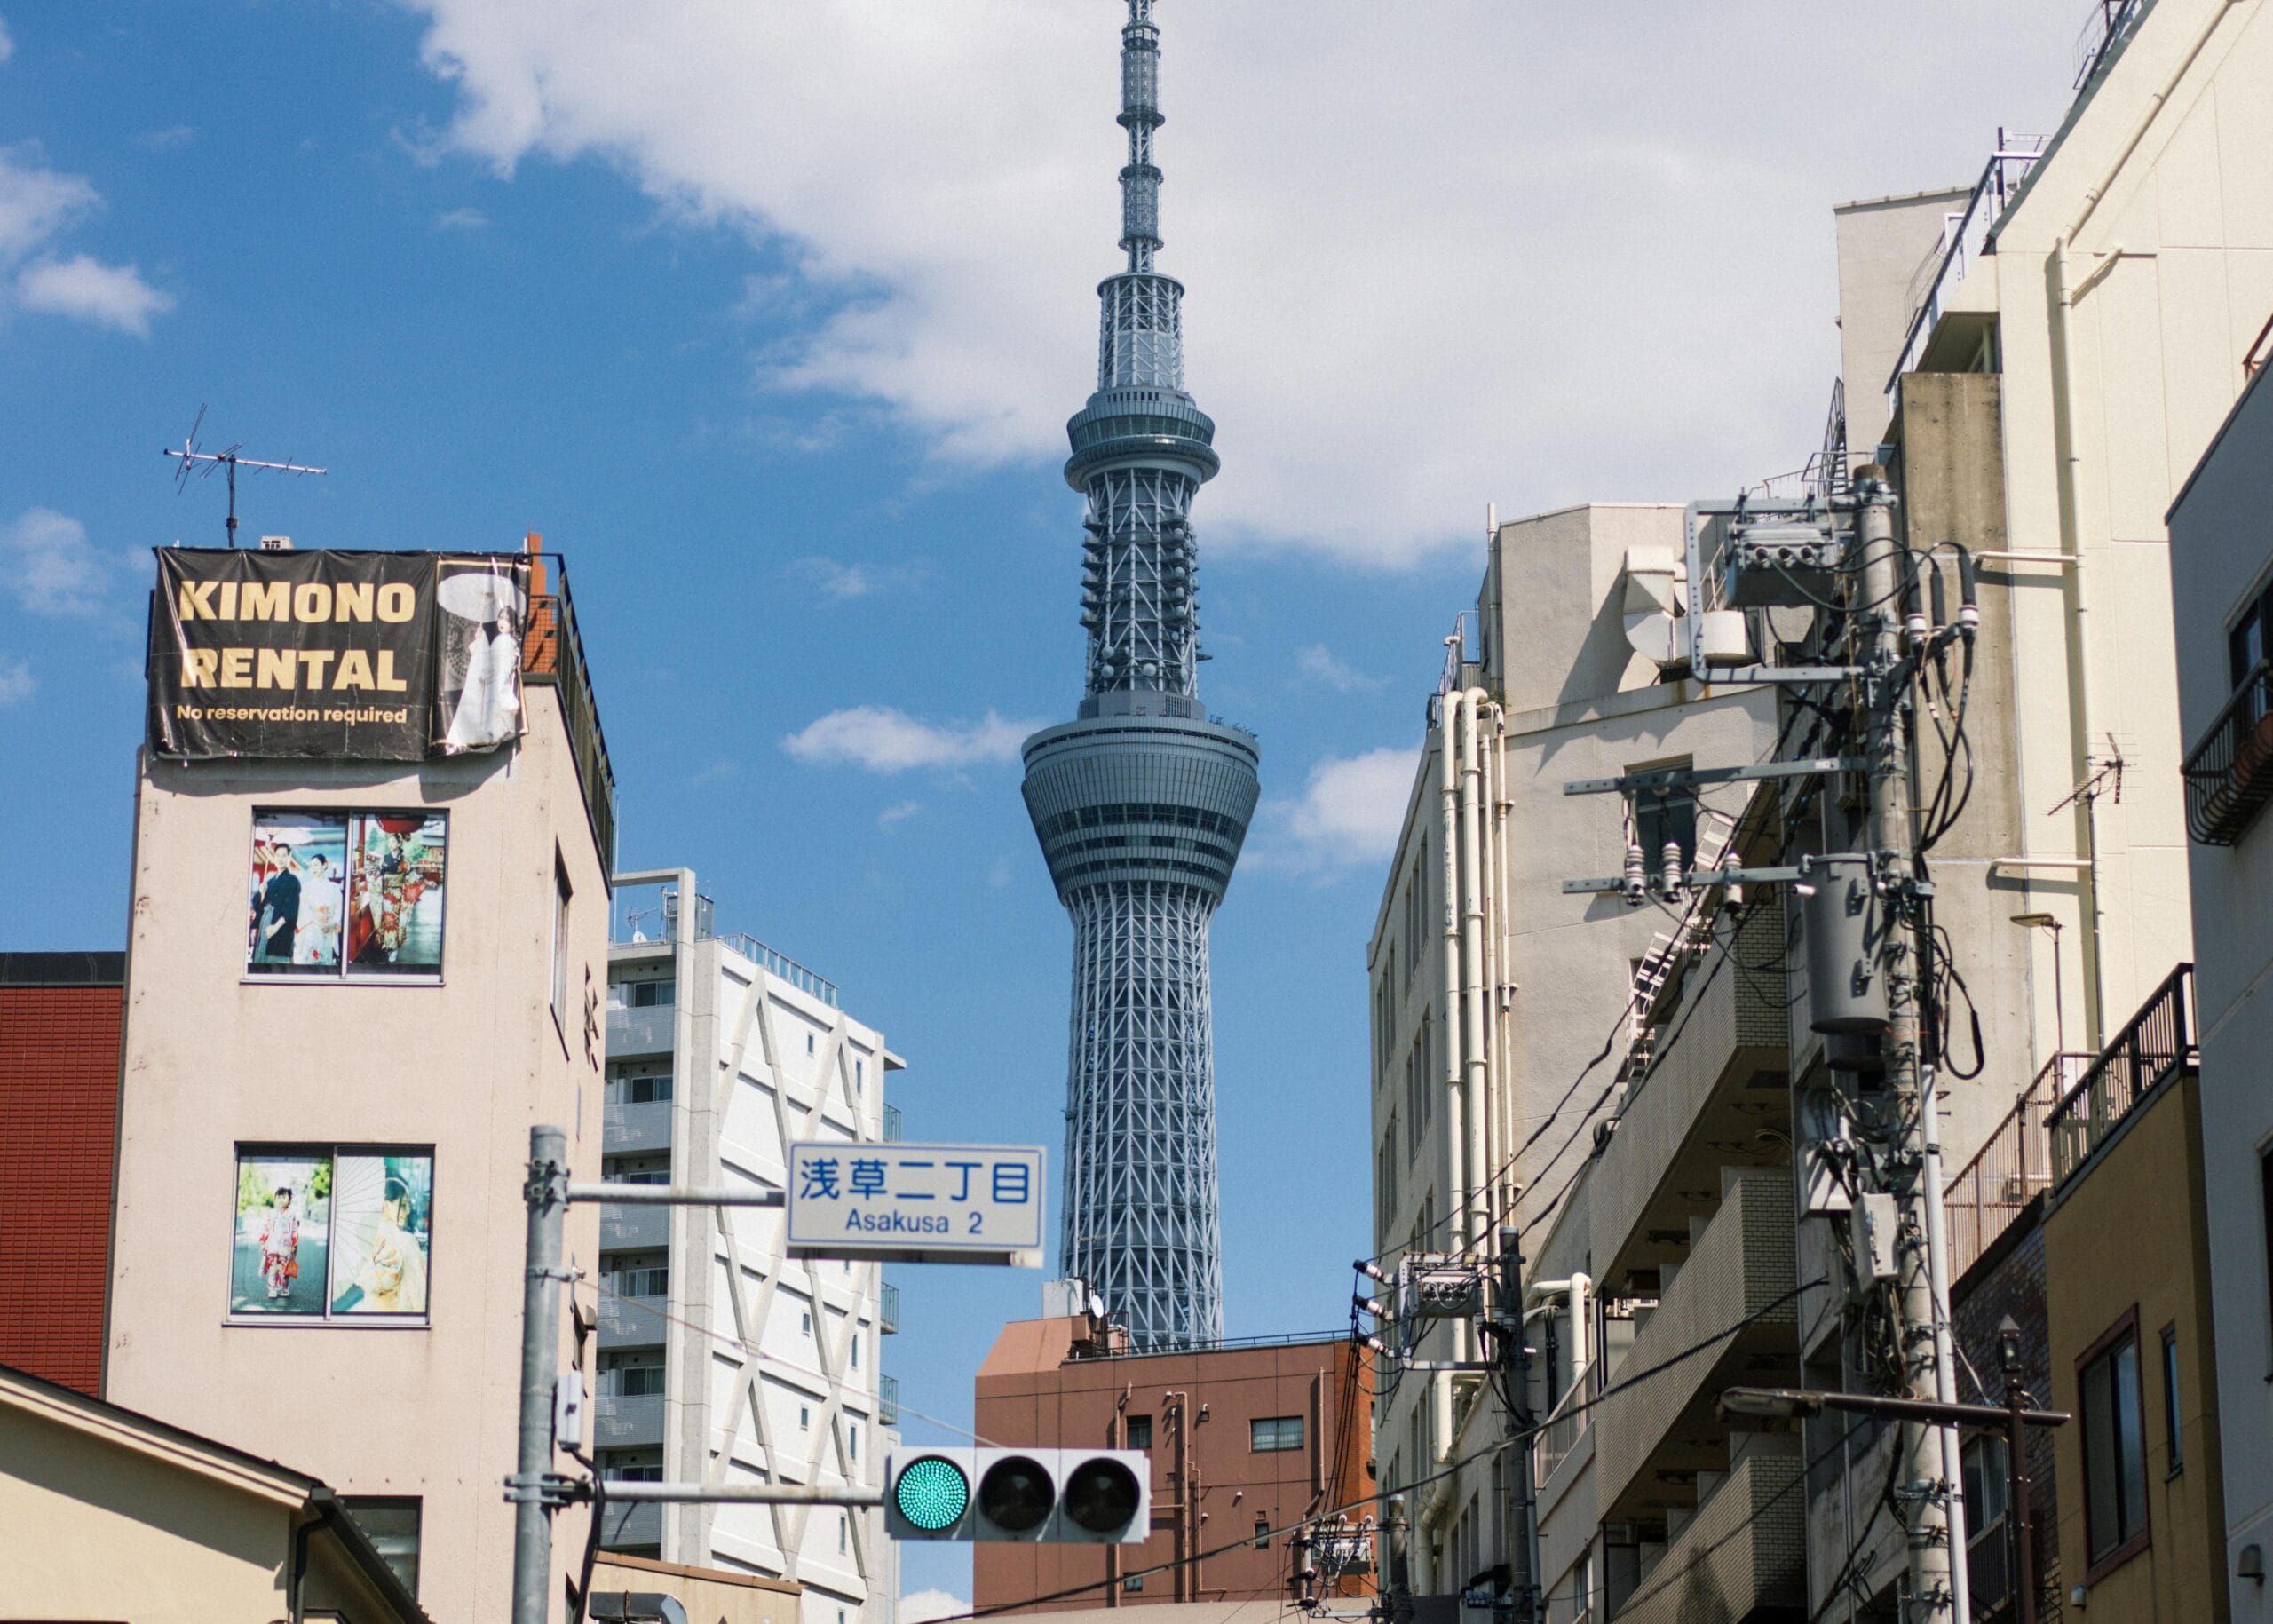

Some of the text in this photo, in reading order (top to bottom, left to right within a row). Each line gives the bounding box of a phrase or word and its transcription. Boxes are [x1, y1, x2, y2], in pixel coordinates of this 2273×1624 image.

[179, 580, 415, 622] KIMONO
[180, 647, 407, 692] RENTAL
[178, 706, 407, 725] No reservation required
[799, 1158, 1029, 1204] 浅草二丁目
[845, 1208, 984, 1235] Asakusa 2
